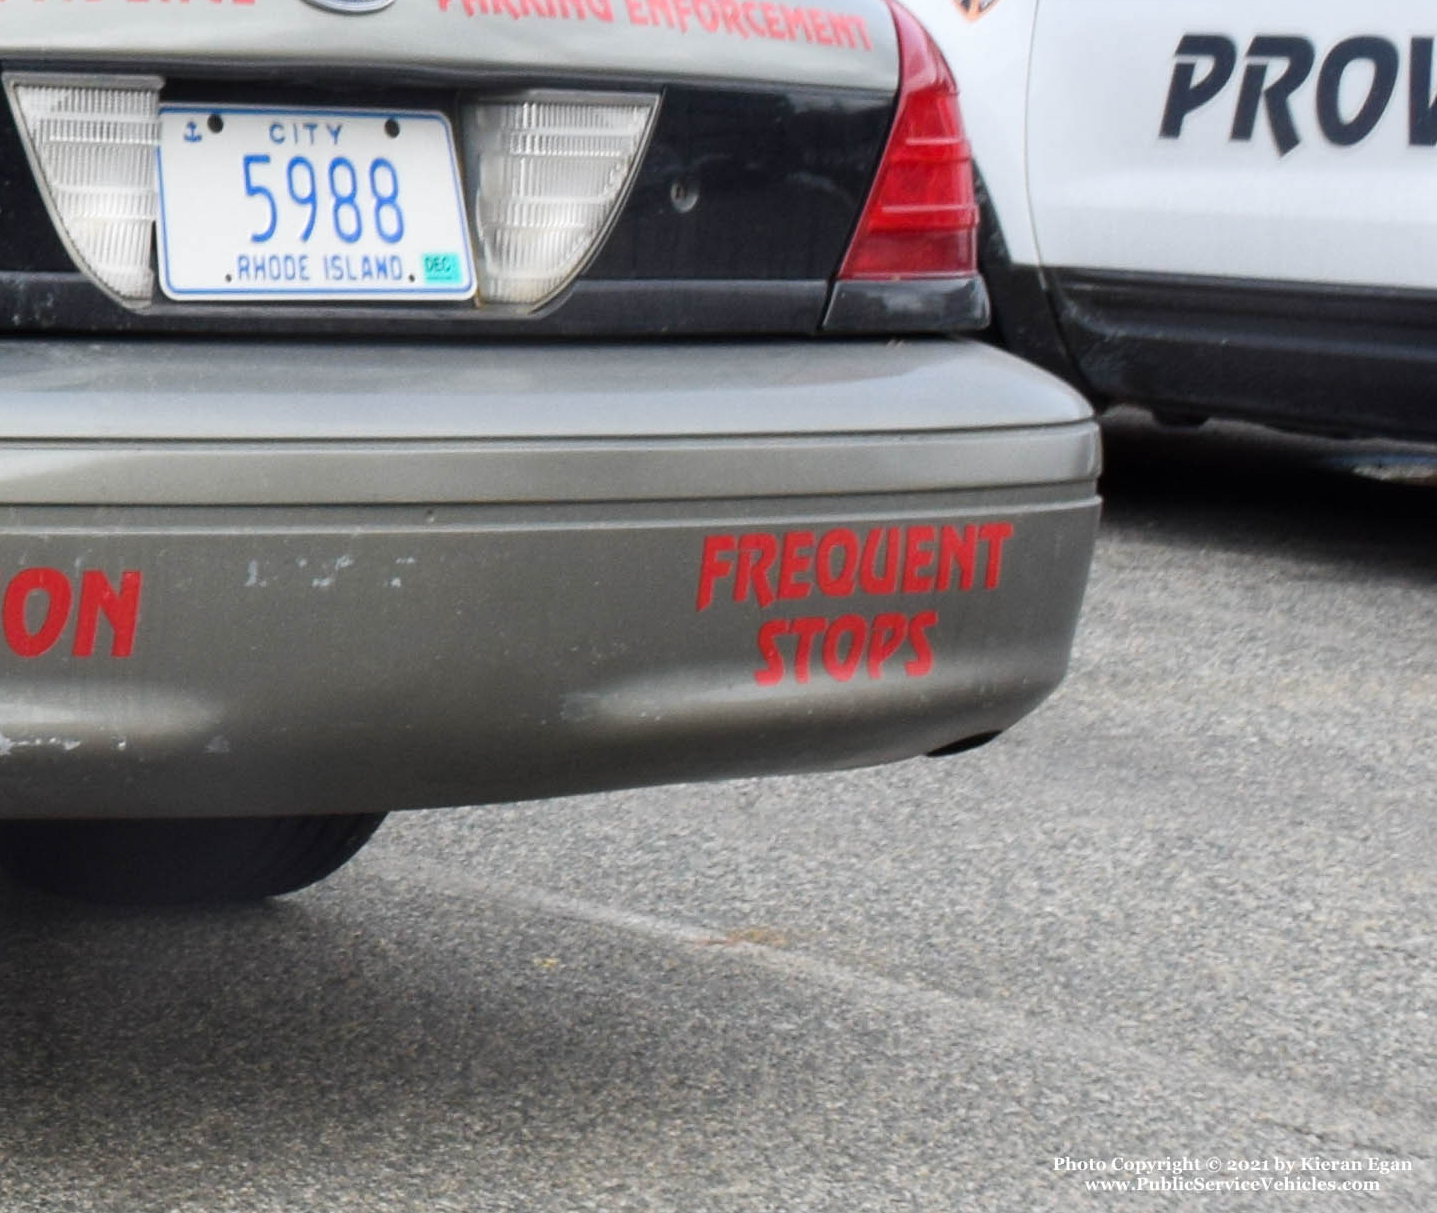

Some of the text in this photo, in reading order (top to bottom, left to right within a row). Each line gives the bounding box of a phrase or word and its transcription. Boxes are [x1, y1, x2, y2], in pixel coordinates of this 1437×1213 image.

[269, 123, 343, 145] CITY
[242, 154, 404, 243] 5988
[237, 255, 403, 281] RHODE ISLAND
[696, 522, 1013, 612] FREQUENT
[754, 611, 938, 686] STOPS
